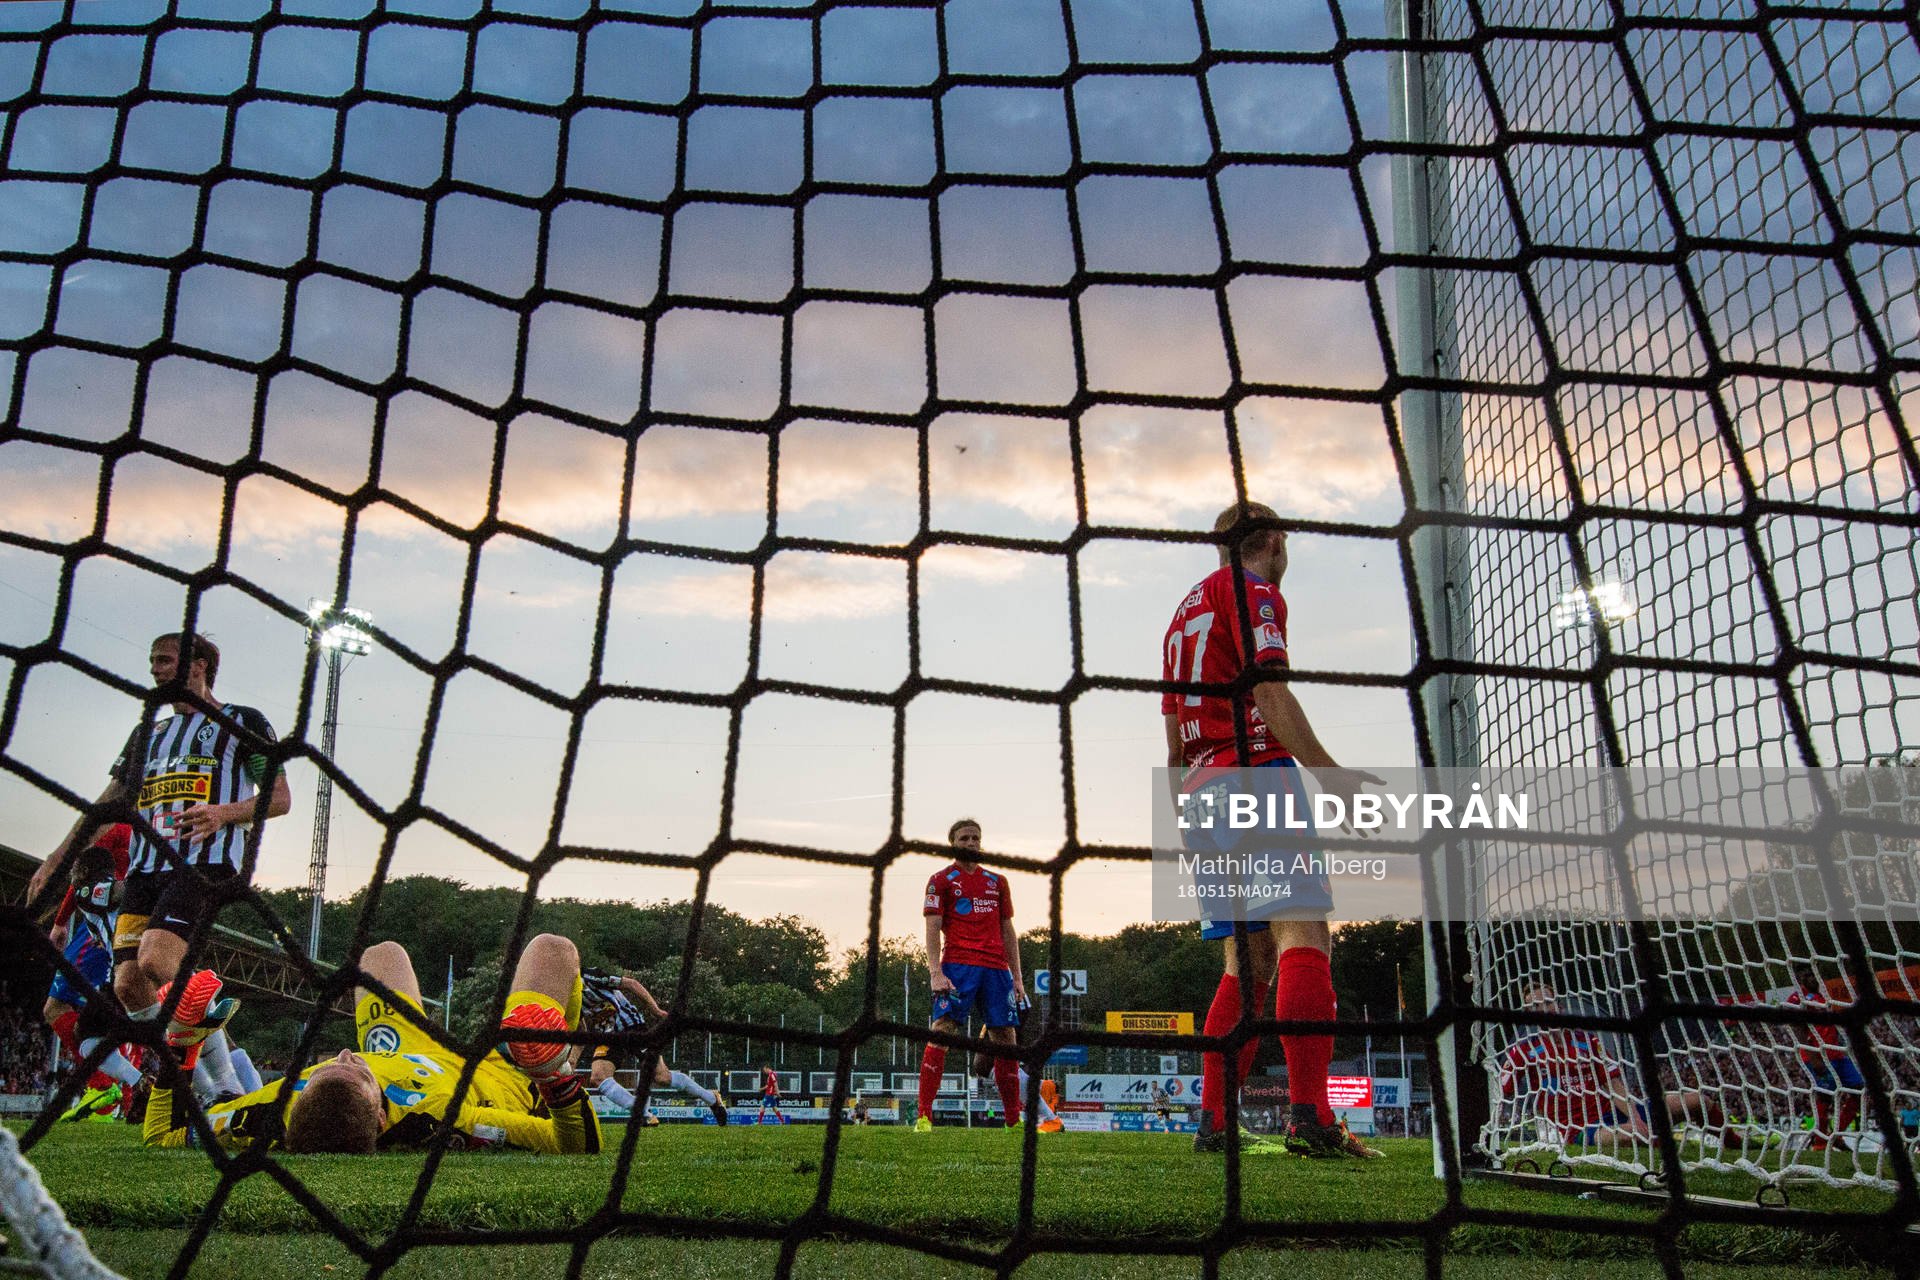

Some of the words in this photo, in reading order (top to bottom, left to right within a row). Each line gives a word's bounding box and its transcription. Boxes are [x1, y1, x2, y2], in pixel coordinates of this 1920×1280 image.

[141, 779, 194, 799] OHLSSONS
[1122, 1018, 1169, 1030] OHLSSONS
[1244, 1085, 1290, 1097] Swedba
[737, 1098, 763, 1107] stadiu
[779, 1098, 810, 1107] stadium
[658, 1108, 687, 1117] Brinova
